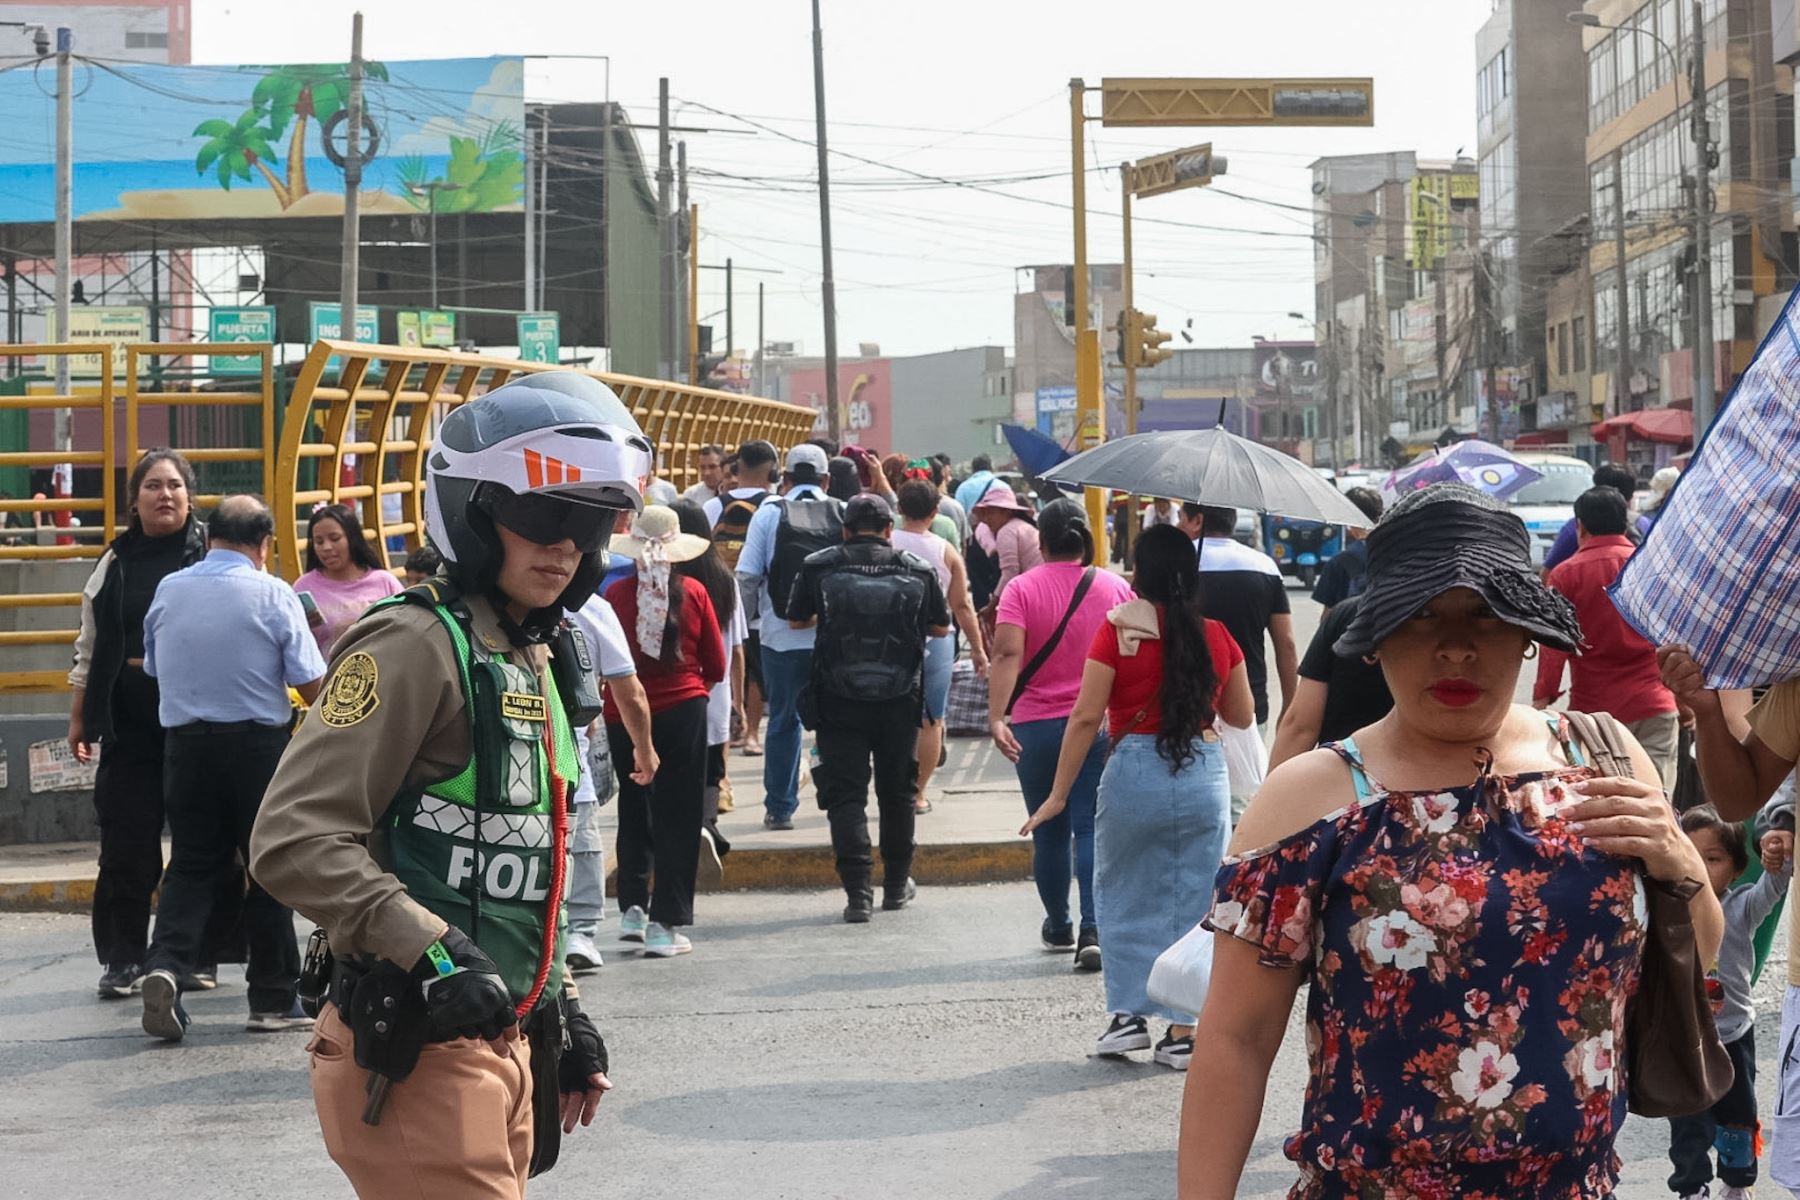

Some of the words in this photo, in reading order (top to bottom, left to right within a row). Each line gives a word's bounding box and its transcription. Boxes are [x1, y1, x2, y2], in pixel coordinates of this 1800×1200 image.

[218, 324, 266, 334] PUERTA
[319, 324, 372, 339] INGSO
[535, 341, 547, 364] 3
